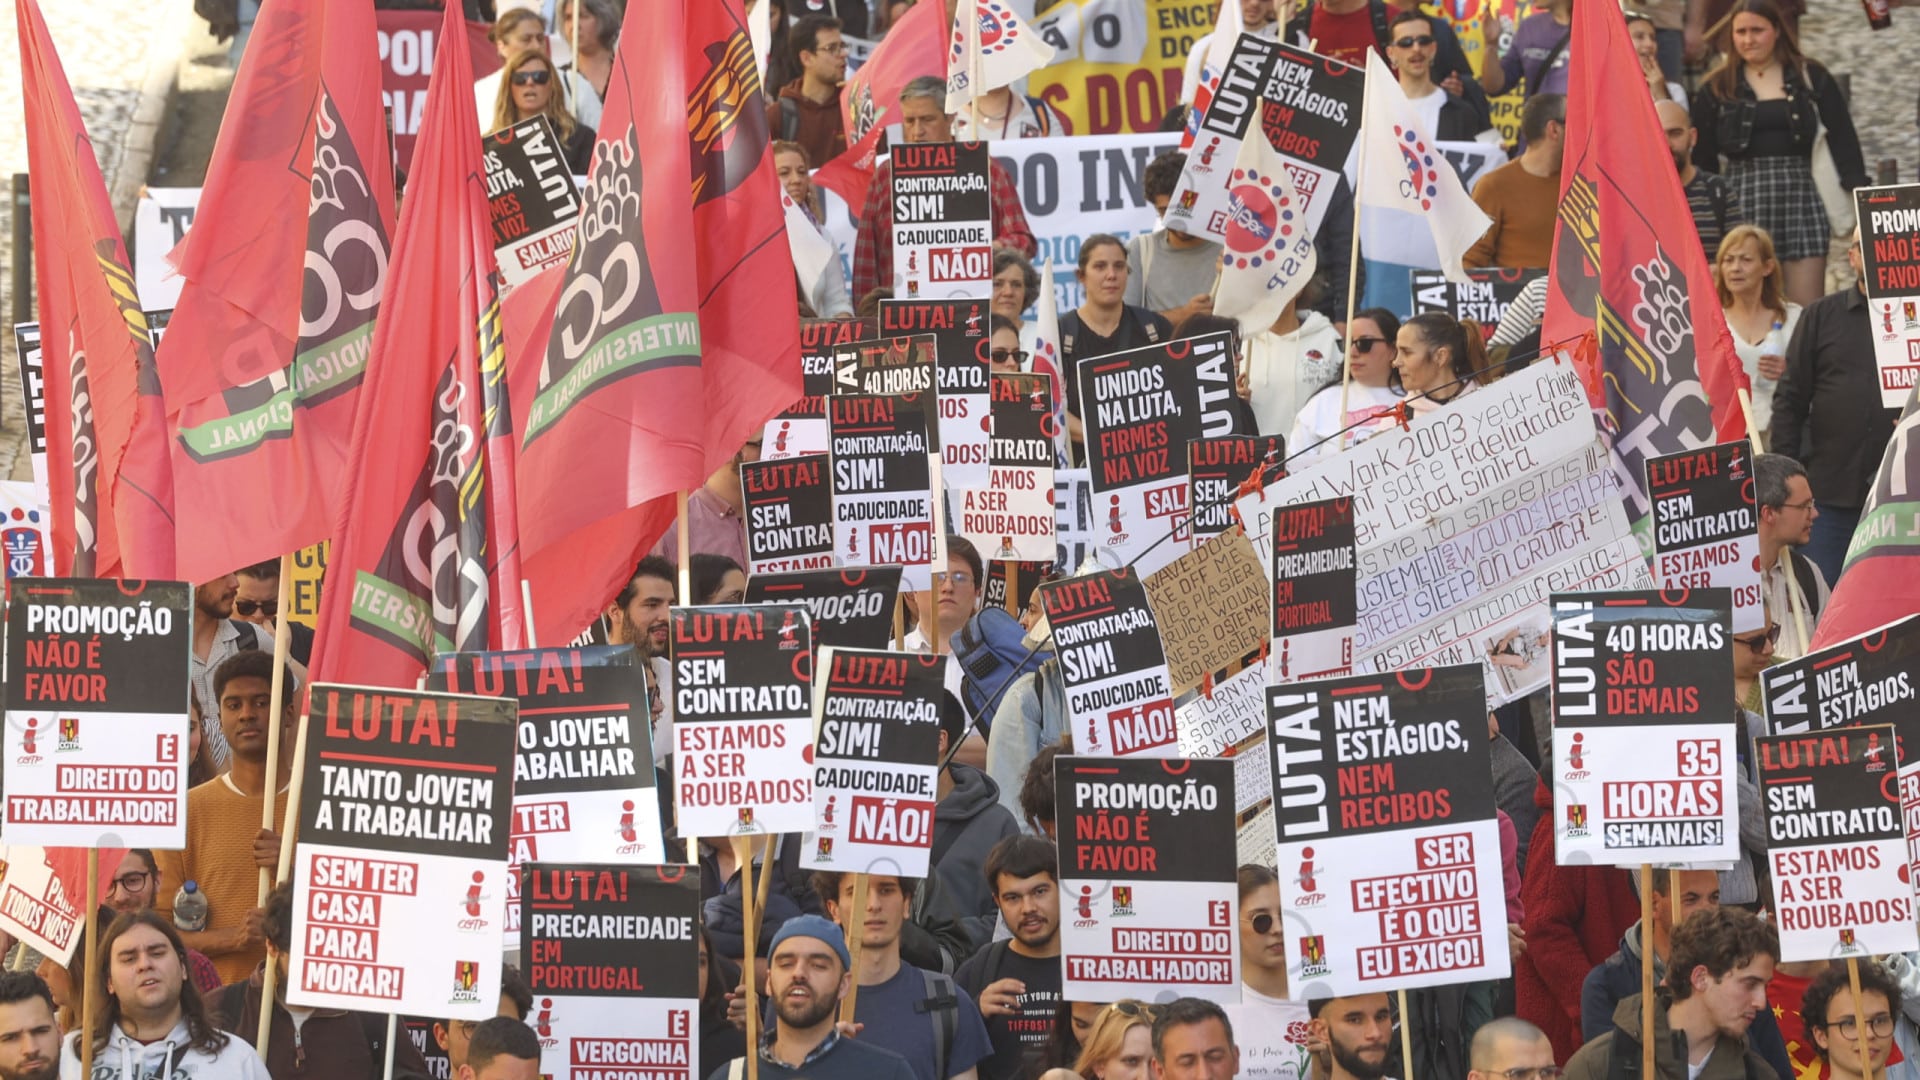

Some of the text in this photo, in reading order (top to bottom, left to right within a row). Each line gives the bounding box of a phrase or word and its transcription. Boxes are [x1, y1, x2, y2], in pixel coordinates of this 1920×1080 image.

[1207, 39, 1271, 134] LUTA!
[1262, 76, 1349, 127] ESTÁGIOS,
[515, 122, 578, 219] LUTA!
[893, 145, 956, 168] LUTA!
[895, 172, 988, 194] CONTRATAÇÃO,
[895, 194, 944, 221] SIM!
[497, 213, 529, 241] VOZ
[897, 227, 989, 246] CADUCIDADE,
[933, 247, 989, 280] NÃO!
[1874, 231, 1908, 263] NÃO
[884, 306, 955, 330] LUTA!
[863, 371, 881, 394] 40
[884, 365, 931, 392] HORAS
[1094, 364, 1164, 401] UNIDOS
[1193, 340, 1234, 438] UTA!
[833, 396, 895, 424] LUTA!
[1097, 389, 1182, 429] NA LUTA,
[834, 430, 925, 456] CONTRATAÇÃO,
[1101, 420, 1169, 458] FIRMES
[1193, 440, 1256, 466] LUTA!
[1397, 413, 1468, 466] 2003
[746, 460, 819, 493] LUTA!
[836, 458, 885, 491] SIM!
[990, 469, 1036, 490] AMOS
[1103, 447, 1170, 485] NA VOZ
[1650, 451, 1718, 487] LUTA!
[964, 490, 1008, 511] A SER
[1194, 479, 1228, 502] SEM
[751, 503, 791, 528] SEM
[838, 498, 929, 522] CADUCIDADE,
[964, 513, 1054, 536] ROUBADOS!
[1278, 505, 1325, 542] LUTA!
[1657, 494, 1694, 522] SEM
[1659, 507, 1755, 546] CONTRATO.
[872, 524, 929, 564] NÃO!
[1661, 542, 1740, 577] ESTAMOS
[1179, 547, 1242, 595] OFF ME
[1278, 546, 1354, 579] PRECARIEDADE
[1042, 577, 1112, 615] LUTA!
[1277, 581, 1294, 604] EM
[27, 601, 172, 641] PROMOÇÃO
[675, 611, 764, 643] LUTA!
[1054, 607, 1155, 647] CONTRATAÇÃO,
[1277, 600, 1333, 630] PORTUGAL
[25, 634, 102, 669] NÃO É
[1605, 622, 1724, 652] 40 HORAS
[445, 650, 584, 696] LUTA!
[677, 659, 726, 687] SEM
[832, 655, 908, 686] LUTA!
[1061, 640, 1117, 682] SIM!
[1556, 600, 1597, 717] LUTA!
[1606, 652, 1655, 686] SÃO
[24, 672, 108, 702] FAVOR
[677, 684, 809, 715] CONTRATO.
[1071, 675, 1169, 715] CADUCIDADE,
[1607, 685, 1700, 715] DEMAIS
[1818, 671, 1915, 729] ESTÁGIOS,
[325, 691, 460, 748] LUTA!
[825, 696, 940, 727] CONTRATAÇÃO,
[543, 716, 630, 748] JOVEM
[680, 724, 786, 751] ESTAMOS
[819, 720, 882, 758] SIM!
[1112, 706, 1174, 752] NÃO!
[1336, 719, 1470, 762] ESTÁGIOS,
[161, 736, 174, 761] É
[681, 752, 746, 778] A SER
[1272, 691, 1330, 837] LUTA!
[1680, 740, 1720, 776] 35
[1761, 736, 1850, 771] LUTA!
[60, 767, 176, 792] DIREITO DO
[320, 765, 493, 810] TANTO JOVEM
[681, 778, 812, 807] ROUBADOS!
[815, 766, 934, 799] CADUCIDADE,
[1337, 762, 1395, 797] NEM
[10, 797, 174, 823] TRABALHADOR!
[1075, 779, 1218, 816] PROMOÇÃO
[1341, 788, 1452, 829] RECIBOS
[1608, 780, 1719, 818] HORAS
[1768, 783, 1816, 813] SEM
[315, 800, 493, 844] A TRABALHAR
[516, 804, 565, 832] TER
[854, 799, 930, 844] NÃO!
[1075, 809, 1150, 841] NÃO É
[1604, 820, 1723, 848] SEMANAIS!
[1769, 805, 1900, 840] CONTRATO.
[1077, 844, 1157, 872] FAVOR
[1422, 835, 1473, 867] SER
[1774, 844, 1881, 877] ESTAMOS
[313, 857, 414, 893] SEM TER
[531, 869, 628, 902] LUTA!
[1356, 868, 1475, 906] EFECTIVO
[1780, 875, 1844, 903] A SER
[4, 888, 45, 931] TODOS
[311, 892, 376, 927] CASA
[1215, 900, 1226, 924] É
[1383, 903, 1477, 940] É O QUE
[1780, 896, 1912, 931] ROUBADOS!
[531, 914, 692, 940] PRECARIEDADE
[1117, 930, 1229, 953] DIREITO DO
[309, 929, 374, 962] PARA
[531, 940, 562, 963] EM
[1361, 938, 1480, 978] EU EXIGO!
[304, 962, 400, 998] MORAR!
[531, 965, 643, 991] PORTUGAL
[1069, 958, 1230, 981] TRABALHADOR!
[673, 1010, 685, 1036] É
[575, 1040, 687, 1065] VERGONHA
